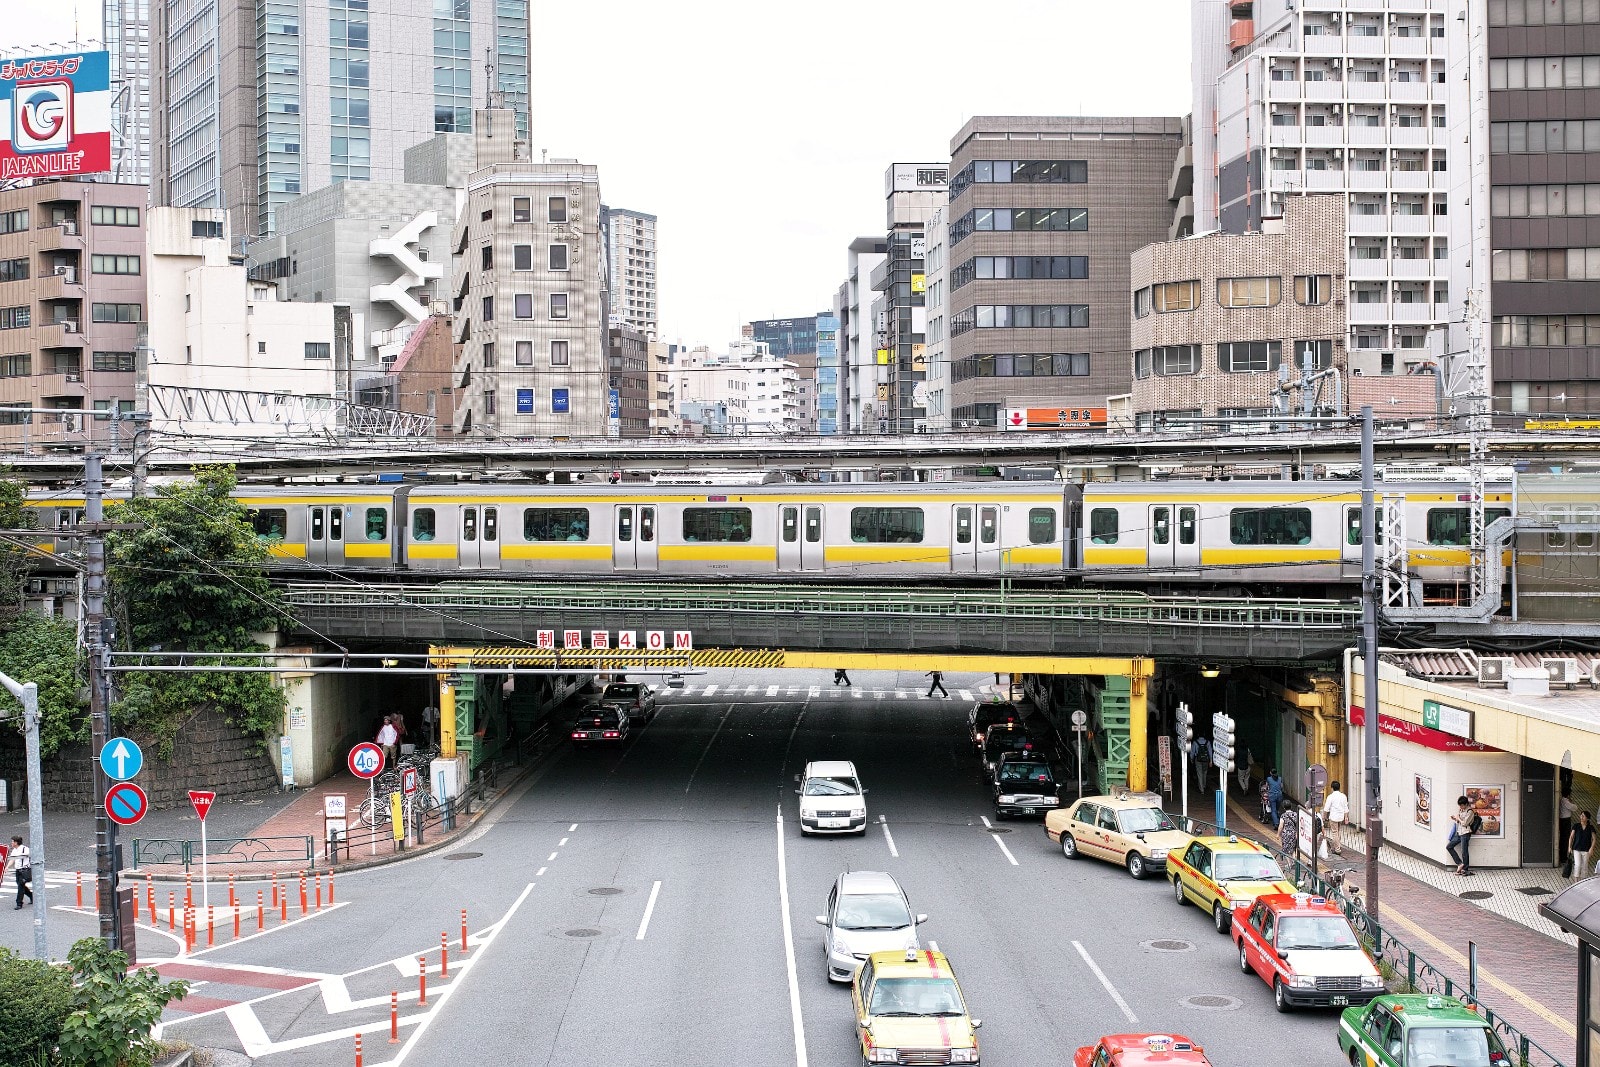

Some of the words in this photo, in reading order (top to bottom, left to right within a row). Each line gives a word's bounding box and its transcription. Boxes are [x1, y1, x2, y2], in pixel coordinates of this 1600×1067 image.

[1, 57, 80, 80] ジャパンライフ
[2, 155, 48, 179] JAPAN
[50, 152, 81, 173] LIFE
[918, 170, 947, 185] 和民
[1058, 410, 1091, 421] 吉野家
[1426, 706, 1437, 721] JR
[194, 796, 211, 805] 止まれ
